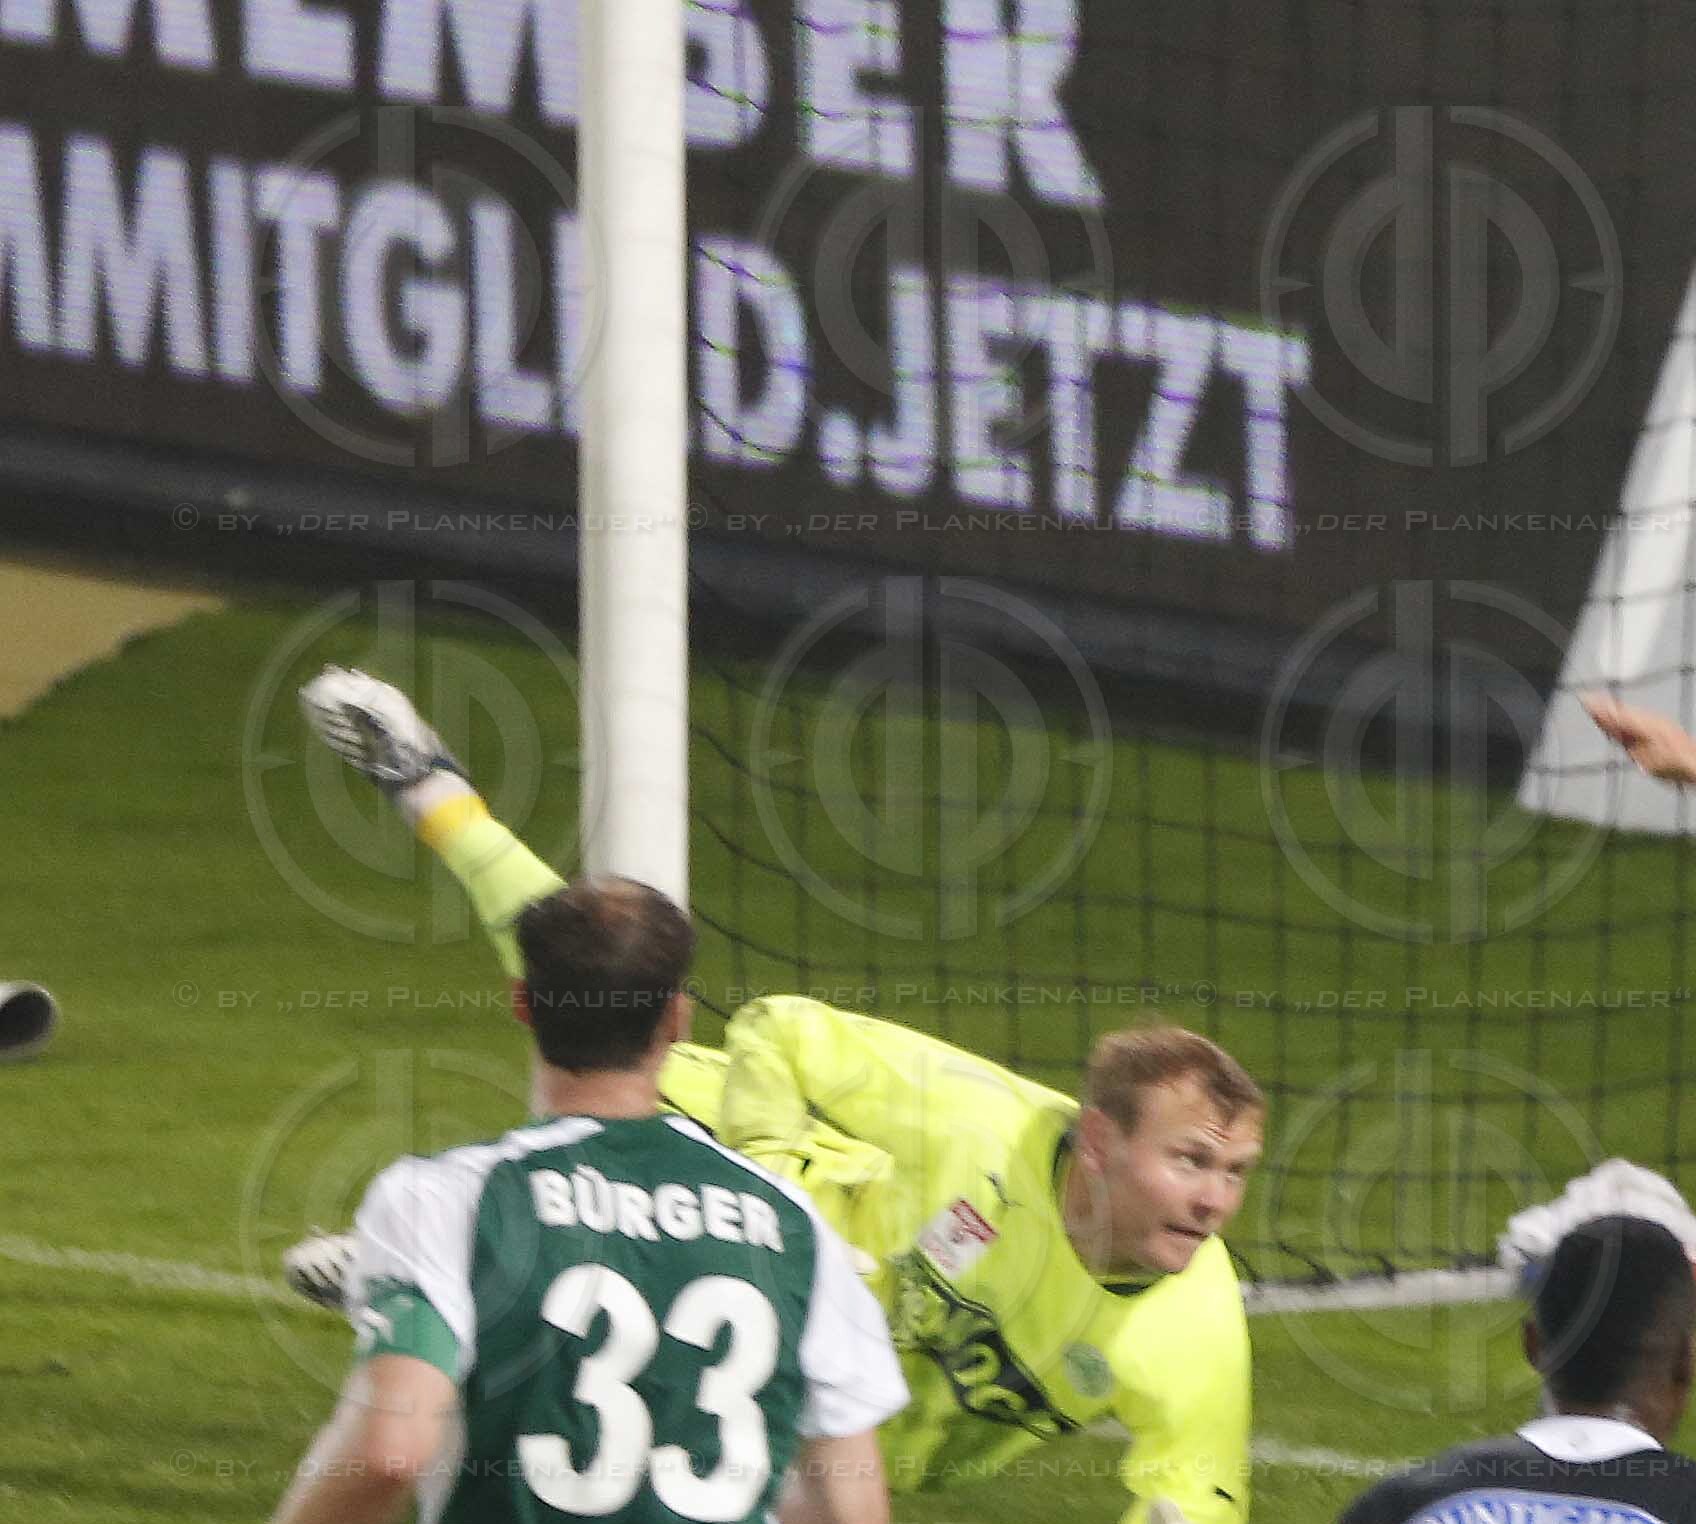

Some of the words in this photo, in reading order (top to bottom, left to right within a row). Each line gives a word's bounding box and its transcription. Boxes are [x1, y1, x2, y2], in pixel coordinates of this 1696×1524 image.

[0, 0, 1106, 206] BER
[0, 122, 1308, 552] MITGLID.JETZT
[529, 1163, 785, 1253] BÜRGER
[516, 1262, 780, 1524] 33
